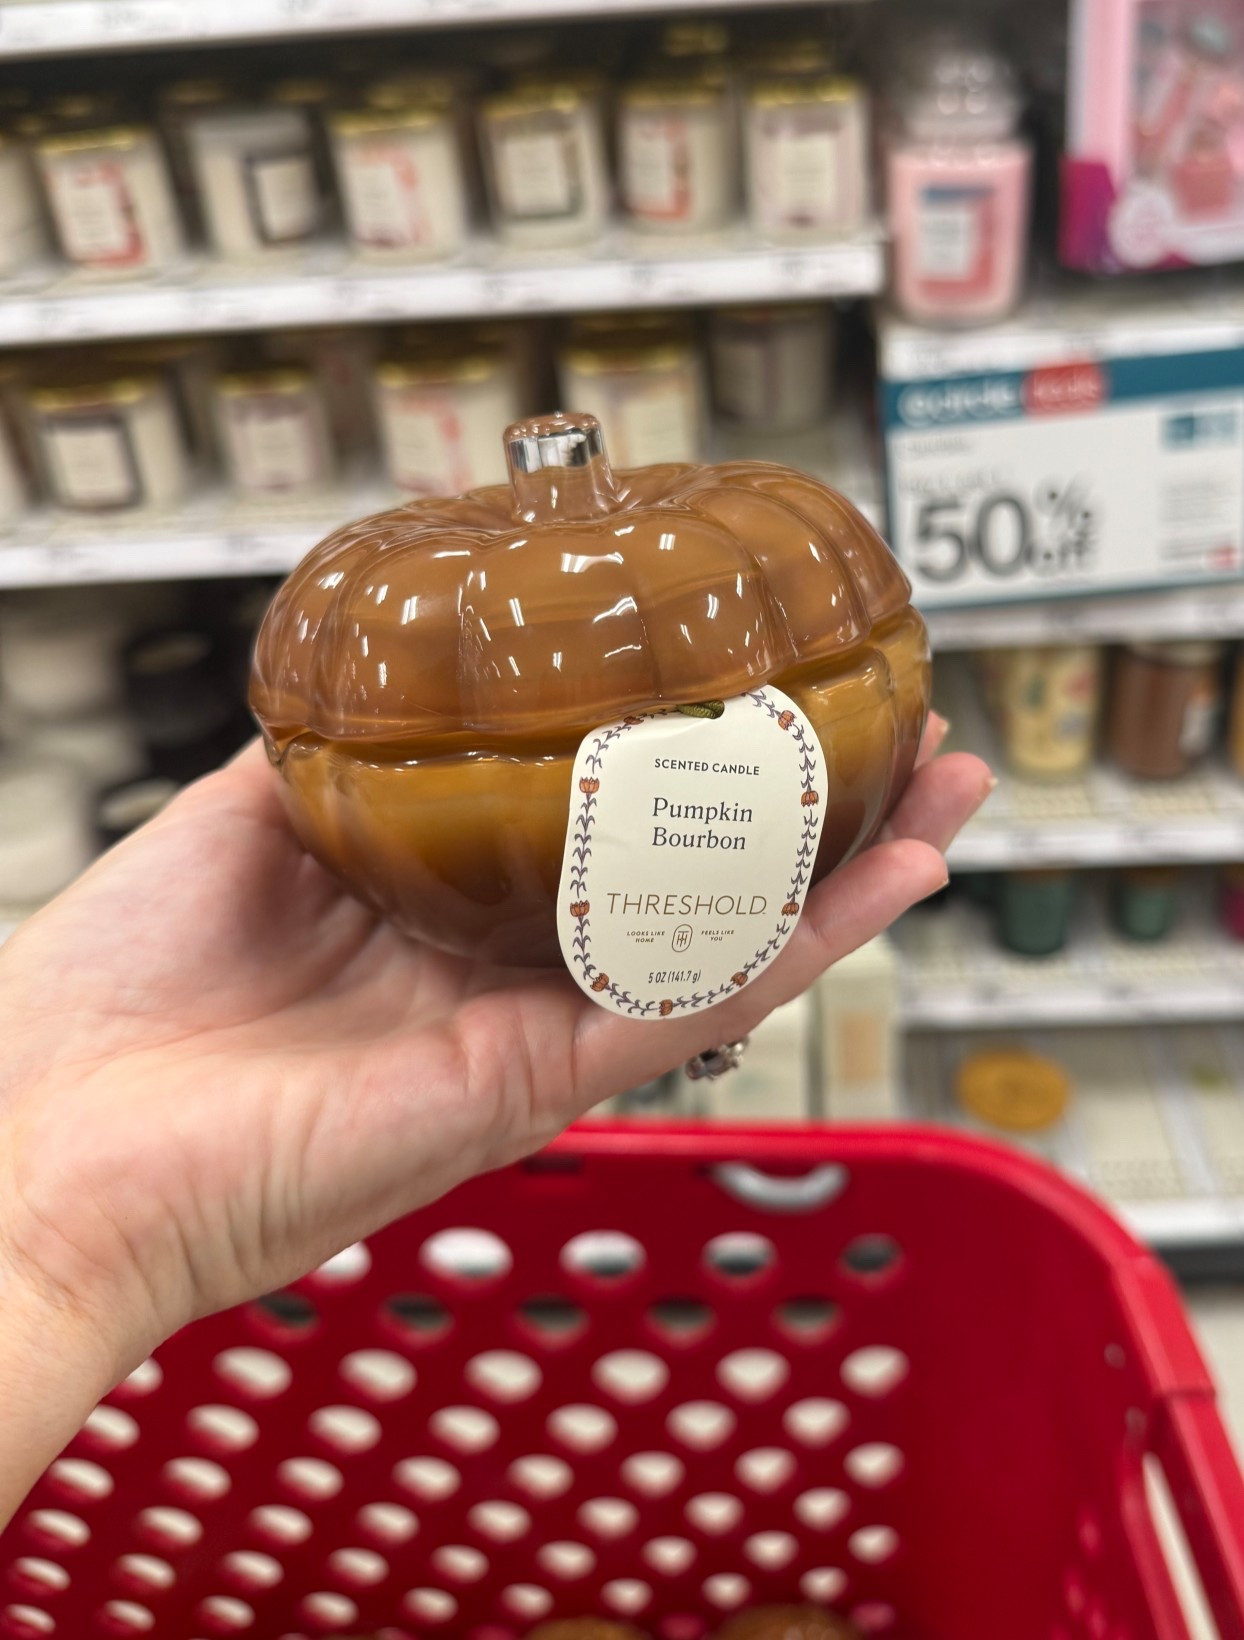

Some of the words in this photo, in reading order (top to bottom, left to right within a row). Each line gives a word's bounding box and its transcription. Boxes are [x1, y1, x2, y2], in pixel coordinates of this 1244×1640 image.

[654, 758, 709, 772] SCENTED
[712, 763, 760, 776] CANDLE
[652, 797, 753, 825] Pumpkin
[652, 826, 746, 850] Bourbon
[607, 893, 767, 915] THRESHOLD
[648, 972, 654, 984] 5
[655, 972, 667, 983] OZ
[667, 971, 692, 984] (141.7
[692, 969, 702, 984] g)
